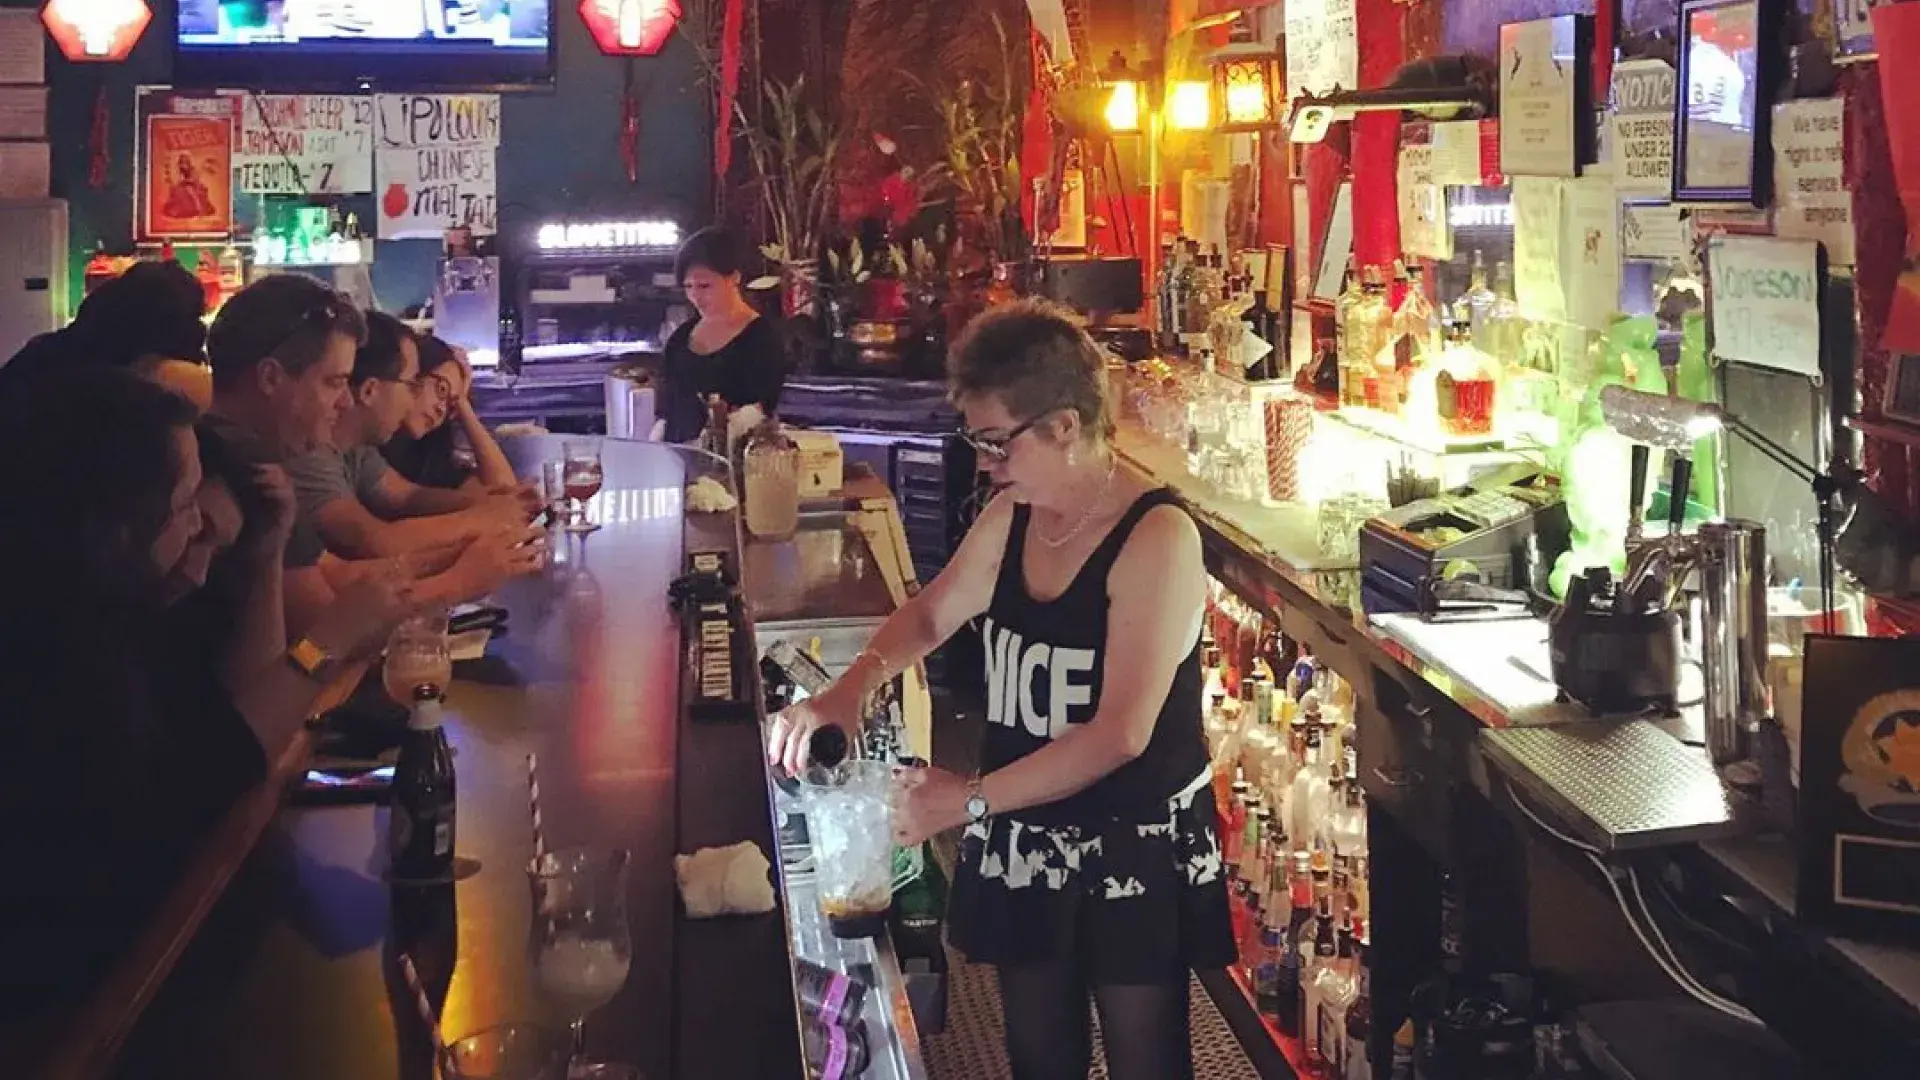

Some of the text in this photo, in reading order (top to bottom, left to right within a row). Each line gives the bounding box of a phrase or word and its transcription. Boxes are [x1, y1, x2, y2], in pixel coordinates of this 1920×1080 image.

[1616, 72, 1672, 110] NOTIC
[1633, 115, 1674, 137] PERSON
[1624, 143, 1657, 159] UNDER
[982, 617, 1096, 740] NICE
